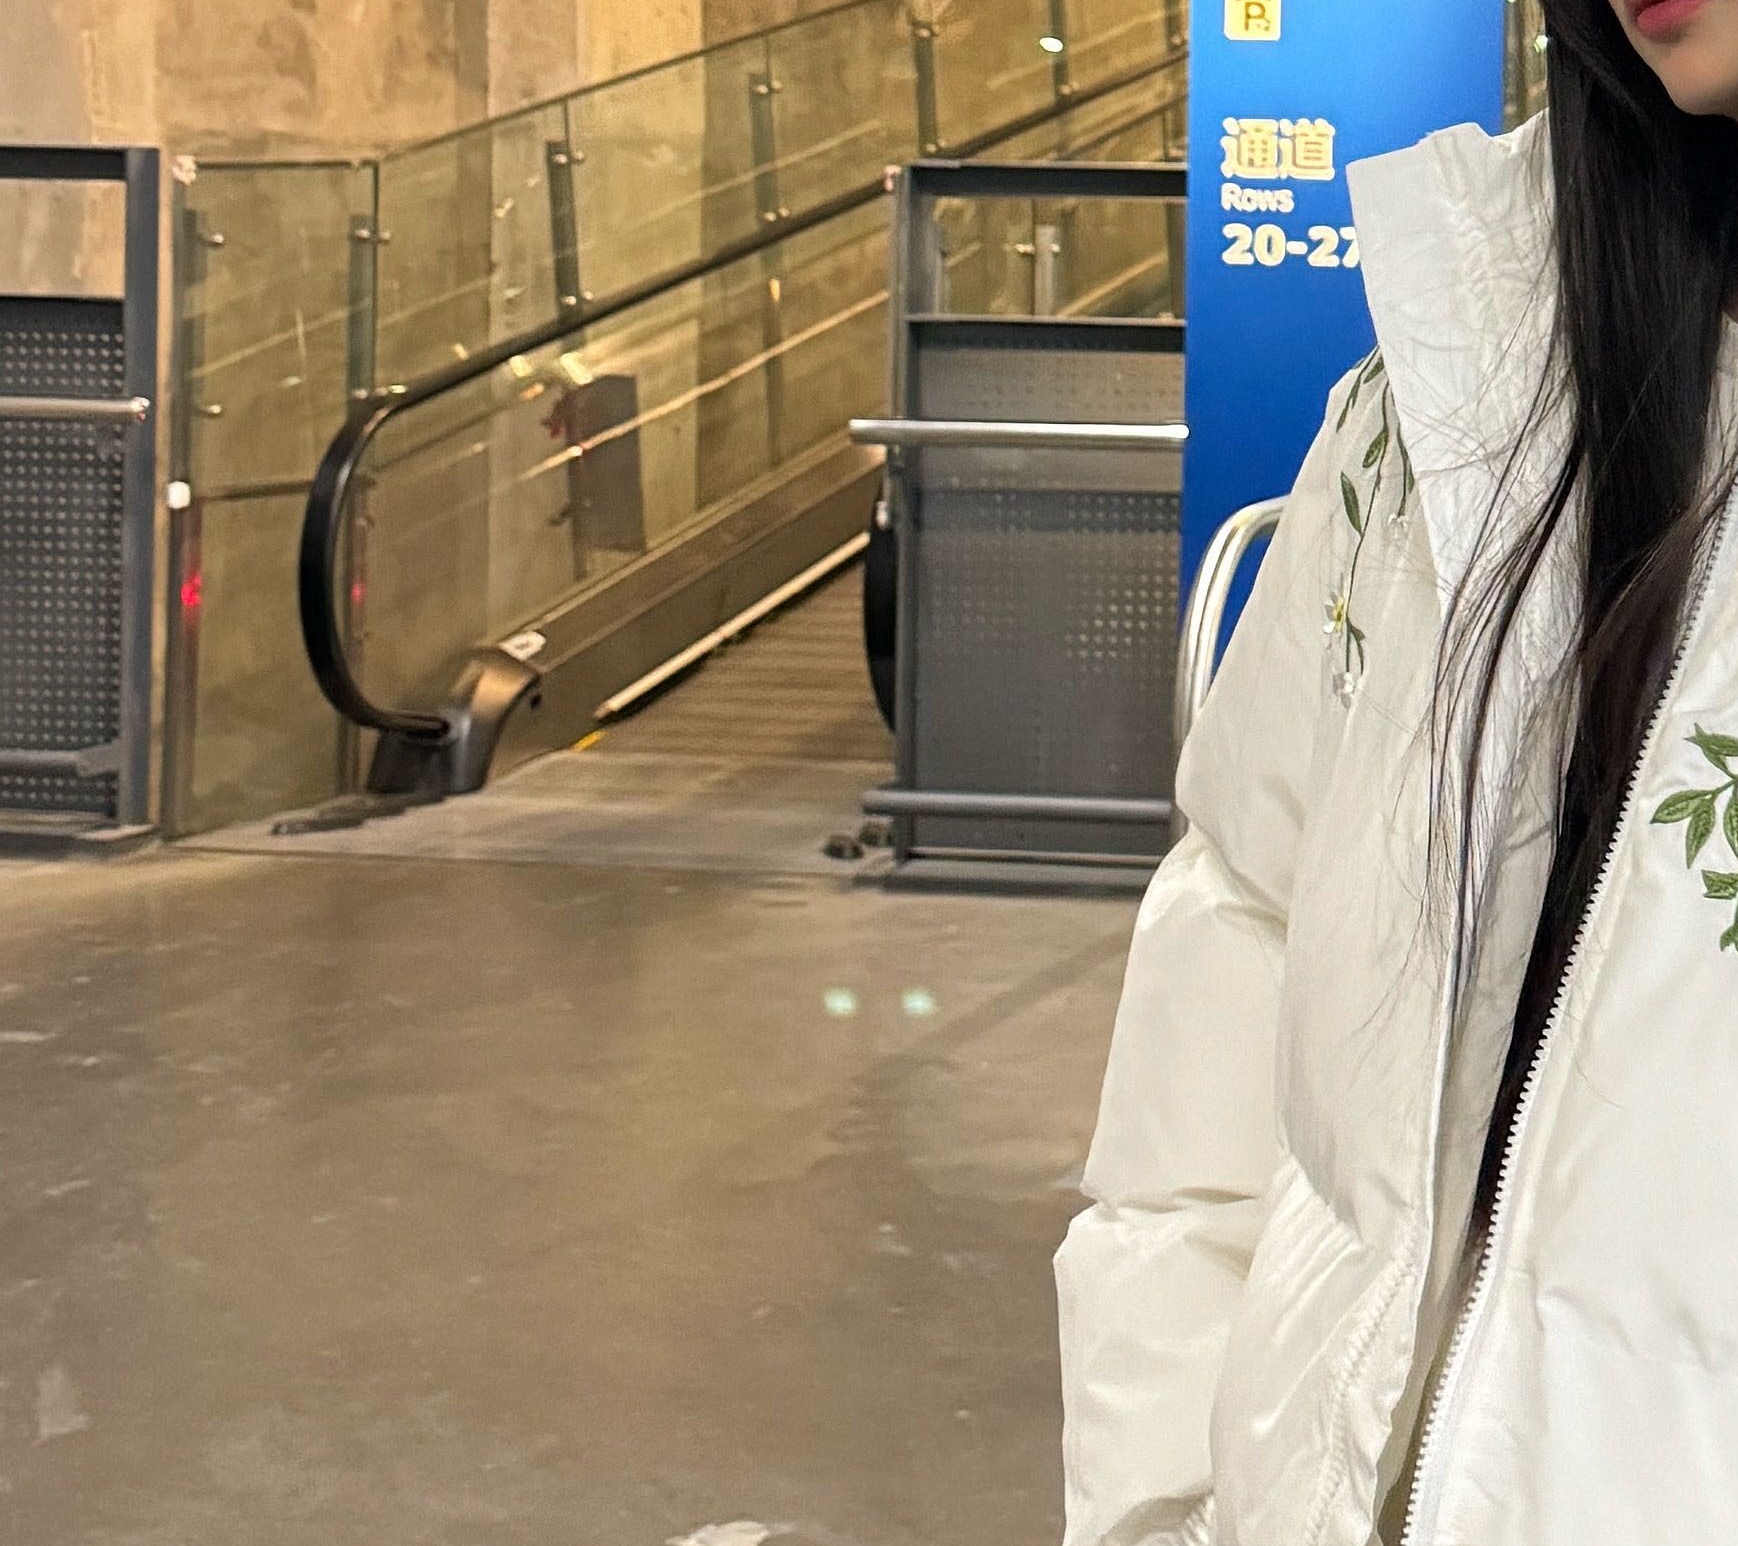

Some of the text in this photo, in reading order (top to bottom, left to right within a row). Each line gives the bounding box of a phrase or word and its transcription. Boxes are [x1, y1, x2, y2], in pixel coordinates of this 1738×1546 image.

[1220, 117, 1335, 180] 通道
[1221, 182, 1294, 212] Rows
[1222, 223, 1360, 268] 20-27
